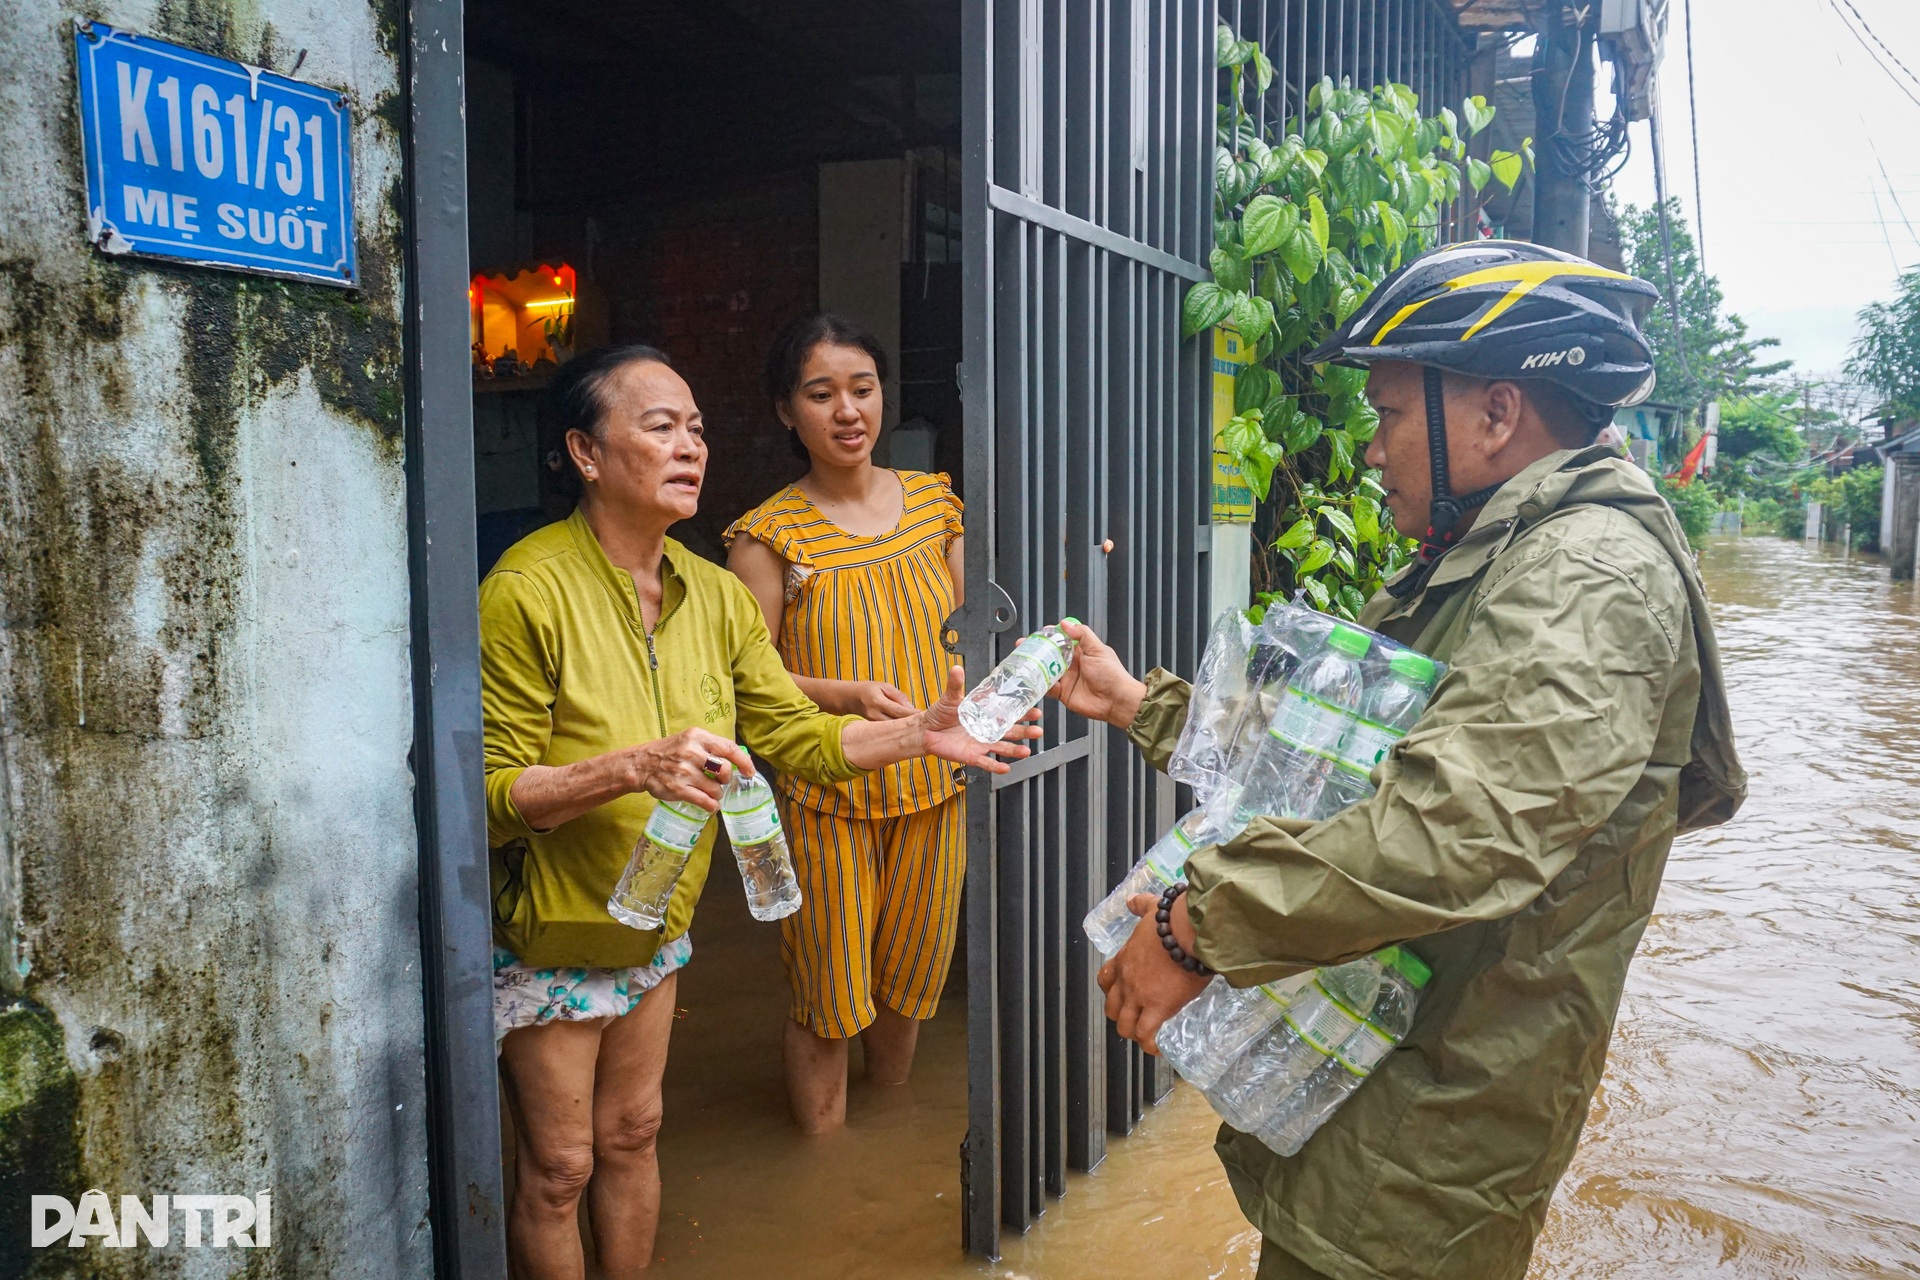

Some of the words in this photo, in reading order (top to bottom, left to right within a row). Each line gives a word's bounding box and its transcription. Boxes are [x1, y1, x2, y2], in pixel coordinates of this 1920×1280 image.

[116, 60, 325, 202] K161/31
[122, 184, 200, 240] MẸ
[216, 204, 328, 255] SUỐT
